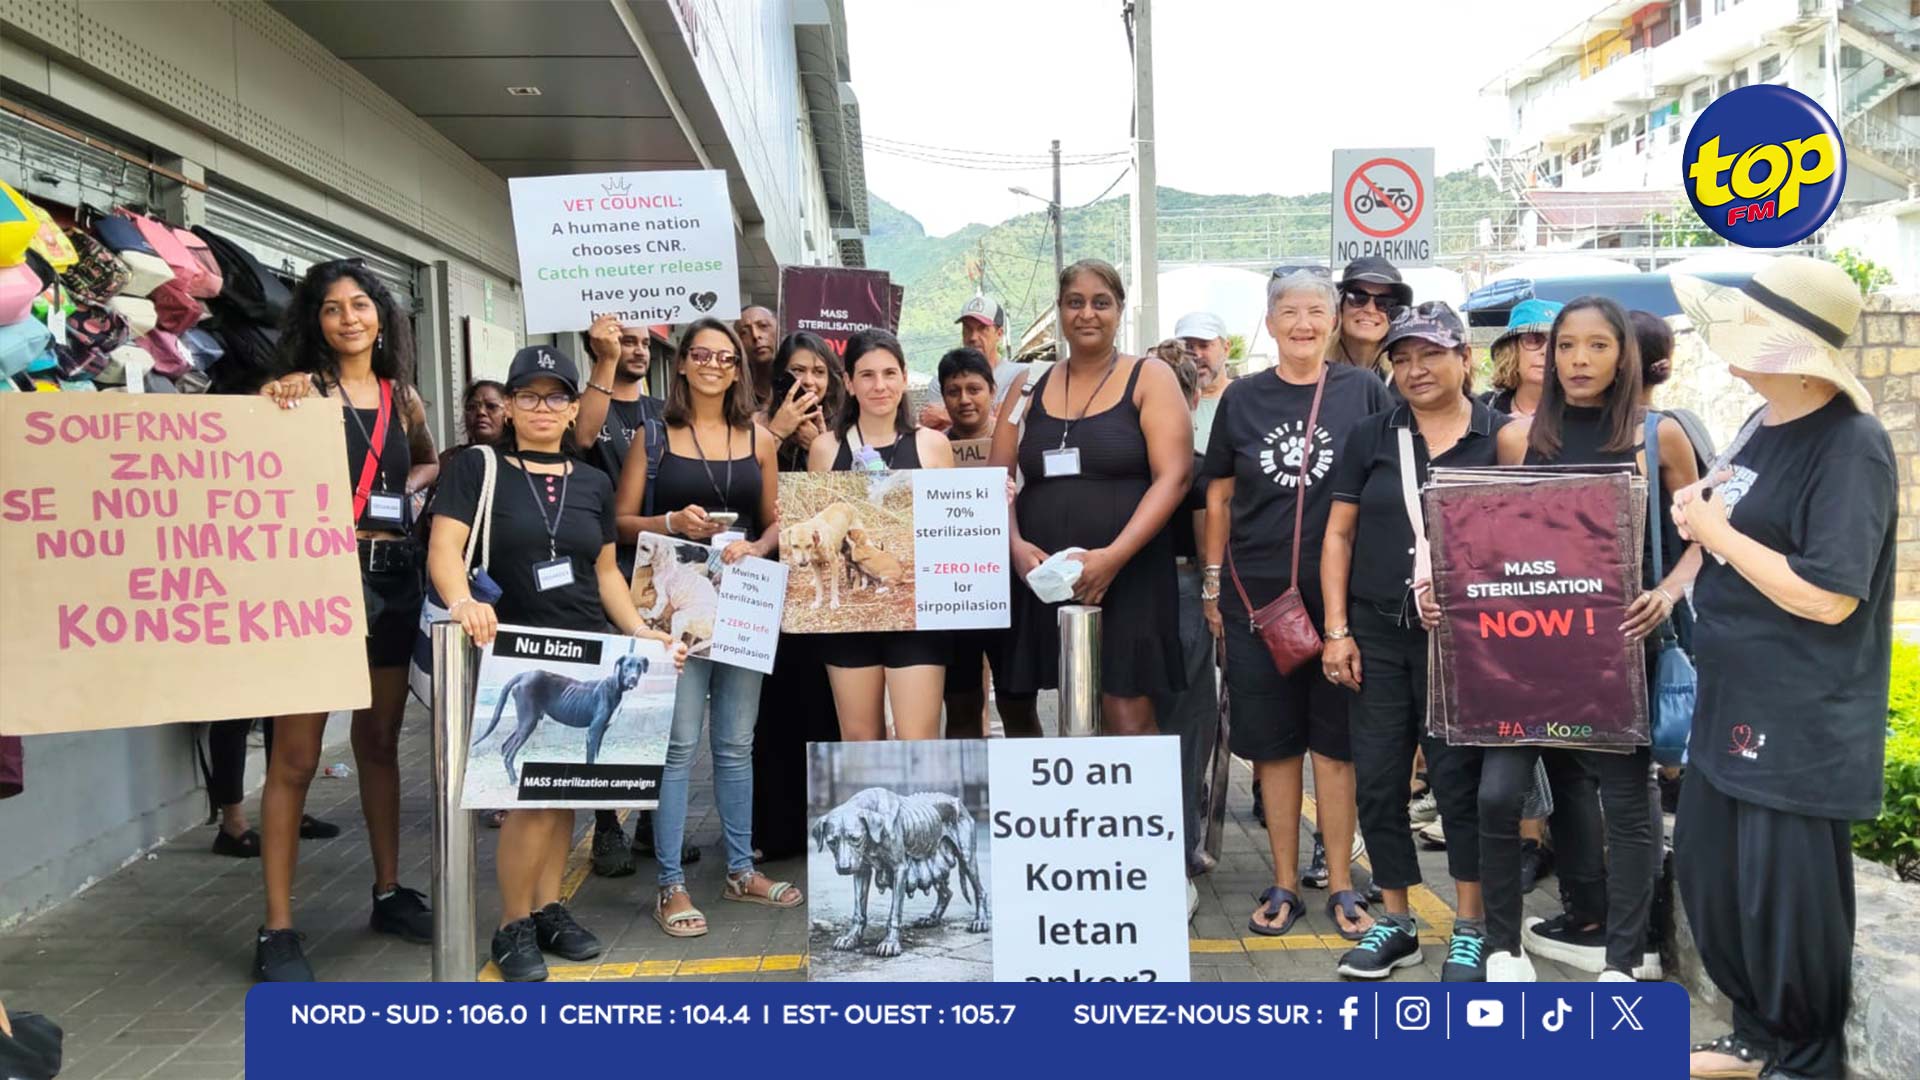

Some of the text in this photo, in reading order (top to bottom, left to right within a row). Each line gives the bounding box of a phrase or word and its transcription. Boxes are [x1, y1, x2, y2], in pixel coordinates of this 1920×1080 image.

[563, 195, 683, 212] VET COUNCIL:
[552, 216, 701, 236] A humane nation
[572, 239, 686, 257] chooses CNR.
[1338, 239, 1430, 261] NO PARKING
[538, 258, 723, 281] Catch neuter release
[581, 284, 686, 304] Have you no
[590, 305, 681, 324] hmanity?
[820, 309, 848, 319] MASS
[537, 350, 556, 369] LA
[24, 411, 228, 445] SOUFRANS
[109, 450, 284, 482] ZANIMO
[1310, 449, 1334, 479] DOGS
[926, 487, 989, 501] Mwins ki
[2, 487, 58, 522] SE
[92, 487, 178, 521] NOU
[207, 488, 295, 520] FOT
[945, 507, 974, 519] 70%
[916, 525, 1002, 539] sterilizasion
[36, 523, 357, 562] NOU INAKTION
[732, 567, 769, 582] Mwins ki
[933, 563, 970, 576] ZERO
[974, 561, 1001, 575] lefe
[1504, 560, 1557, 577] MASS
[128, 566, 227, 602] ENA
[742, 581, 759, 593] 70%
[954, 581, 973, 594] lor
[1466, 578, 1604, 599] STERILISATION
[720, 592, 774, 610] sterilizasion
[916, 598, 1008, 615] sirpopilasion
[58, 595, 353, 650] KONSEKANS
[727, 617, 750, 630] ZERO
[1478, 608, 1574, 640] NOW
[514, 636, 583, 659] Nu bizin
[737, 633, 751, 643] lor
[712, 642, 770, 661] sirpopilasion
[1496, 720, 1593, 739] #AseKoze
[1031, 757, 1133, 786] 50 an
[523, 776, 656, 791] MASS sterilization campaigns
[993, 808, 1175, 841] Soufrans,
[1025, 861, 1148, 892] Komie
[1038, 915, 1138, 945] letan
